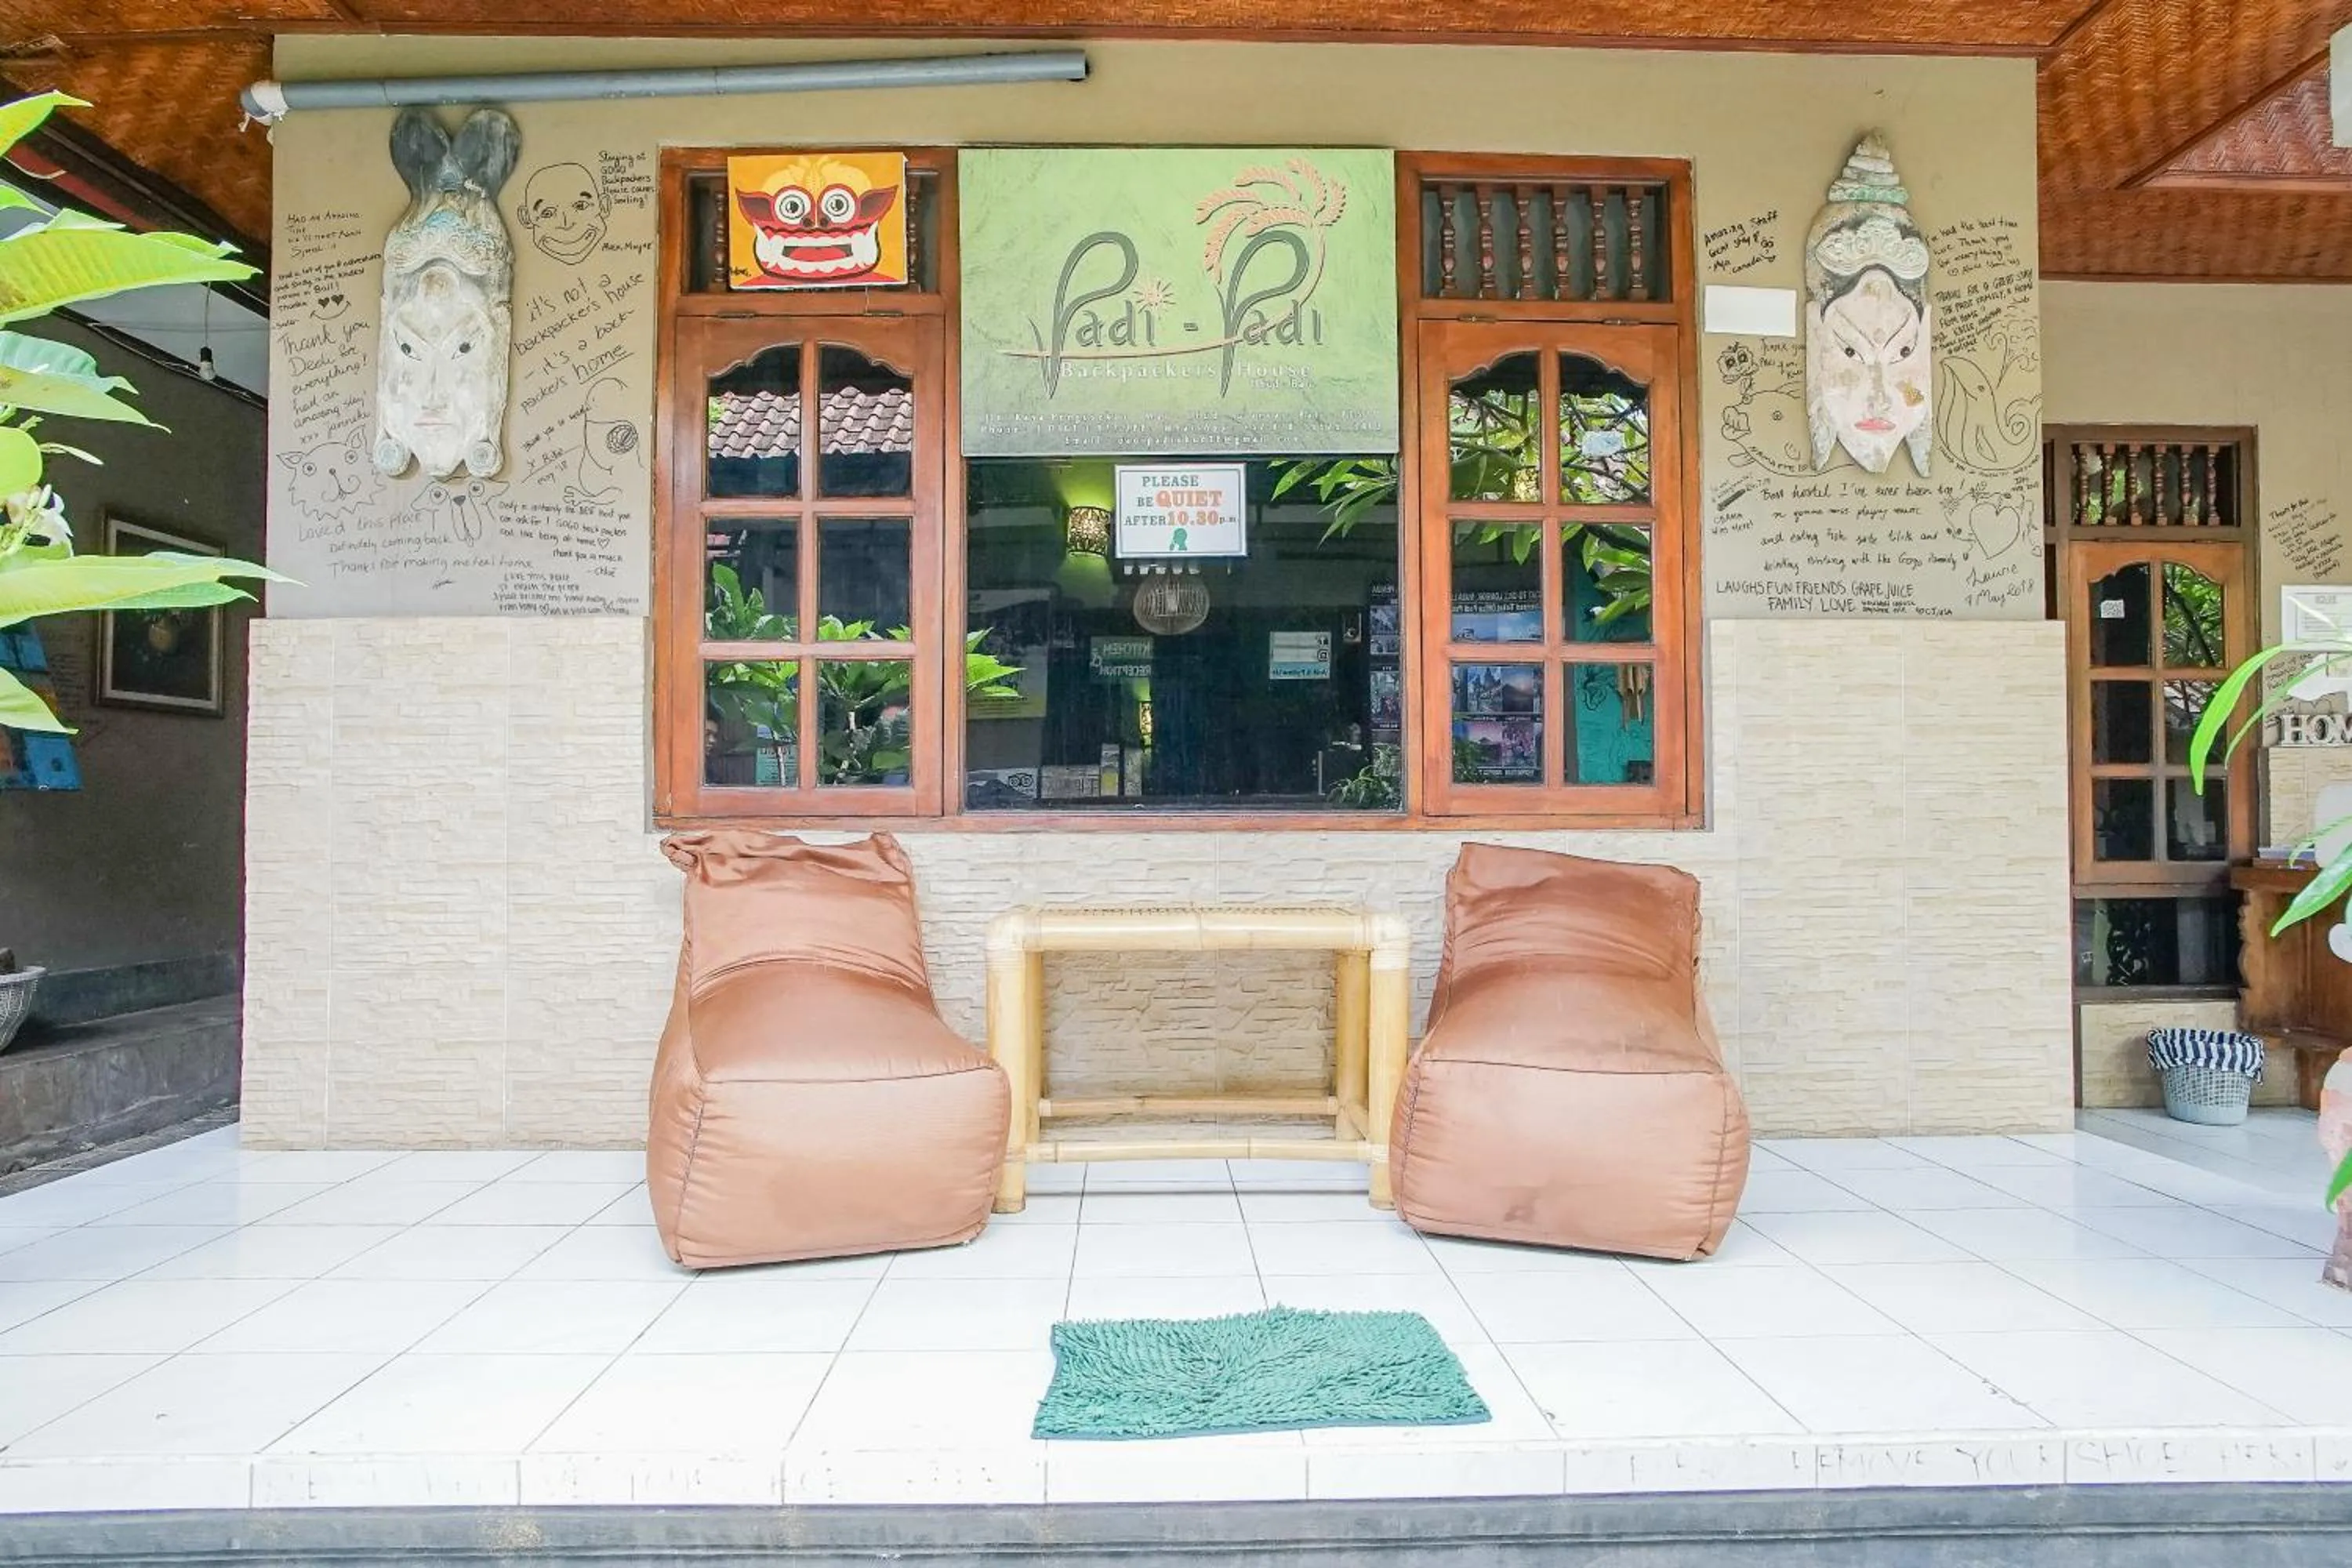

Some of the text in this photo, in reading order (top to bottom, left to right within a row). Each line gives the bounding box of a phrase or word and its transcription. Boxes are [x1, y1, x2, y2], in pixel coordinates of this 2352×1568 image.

[604, 273, 644, 305] house
[1060, 360, 1313, 386] Backpackers House
[1142, 475, 1200, 488] PLEASE
[1138, 490, 1223, 508] BE QUIET
[1124, 515, 1167, 526] AFTER
[1167, 510, 1219, 526] 10.30
[1767, 596, 1813, 612] FAMILY
[1820, 597, 1857, 613] LOVE
